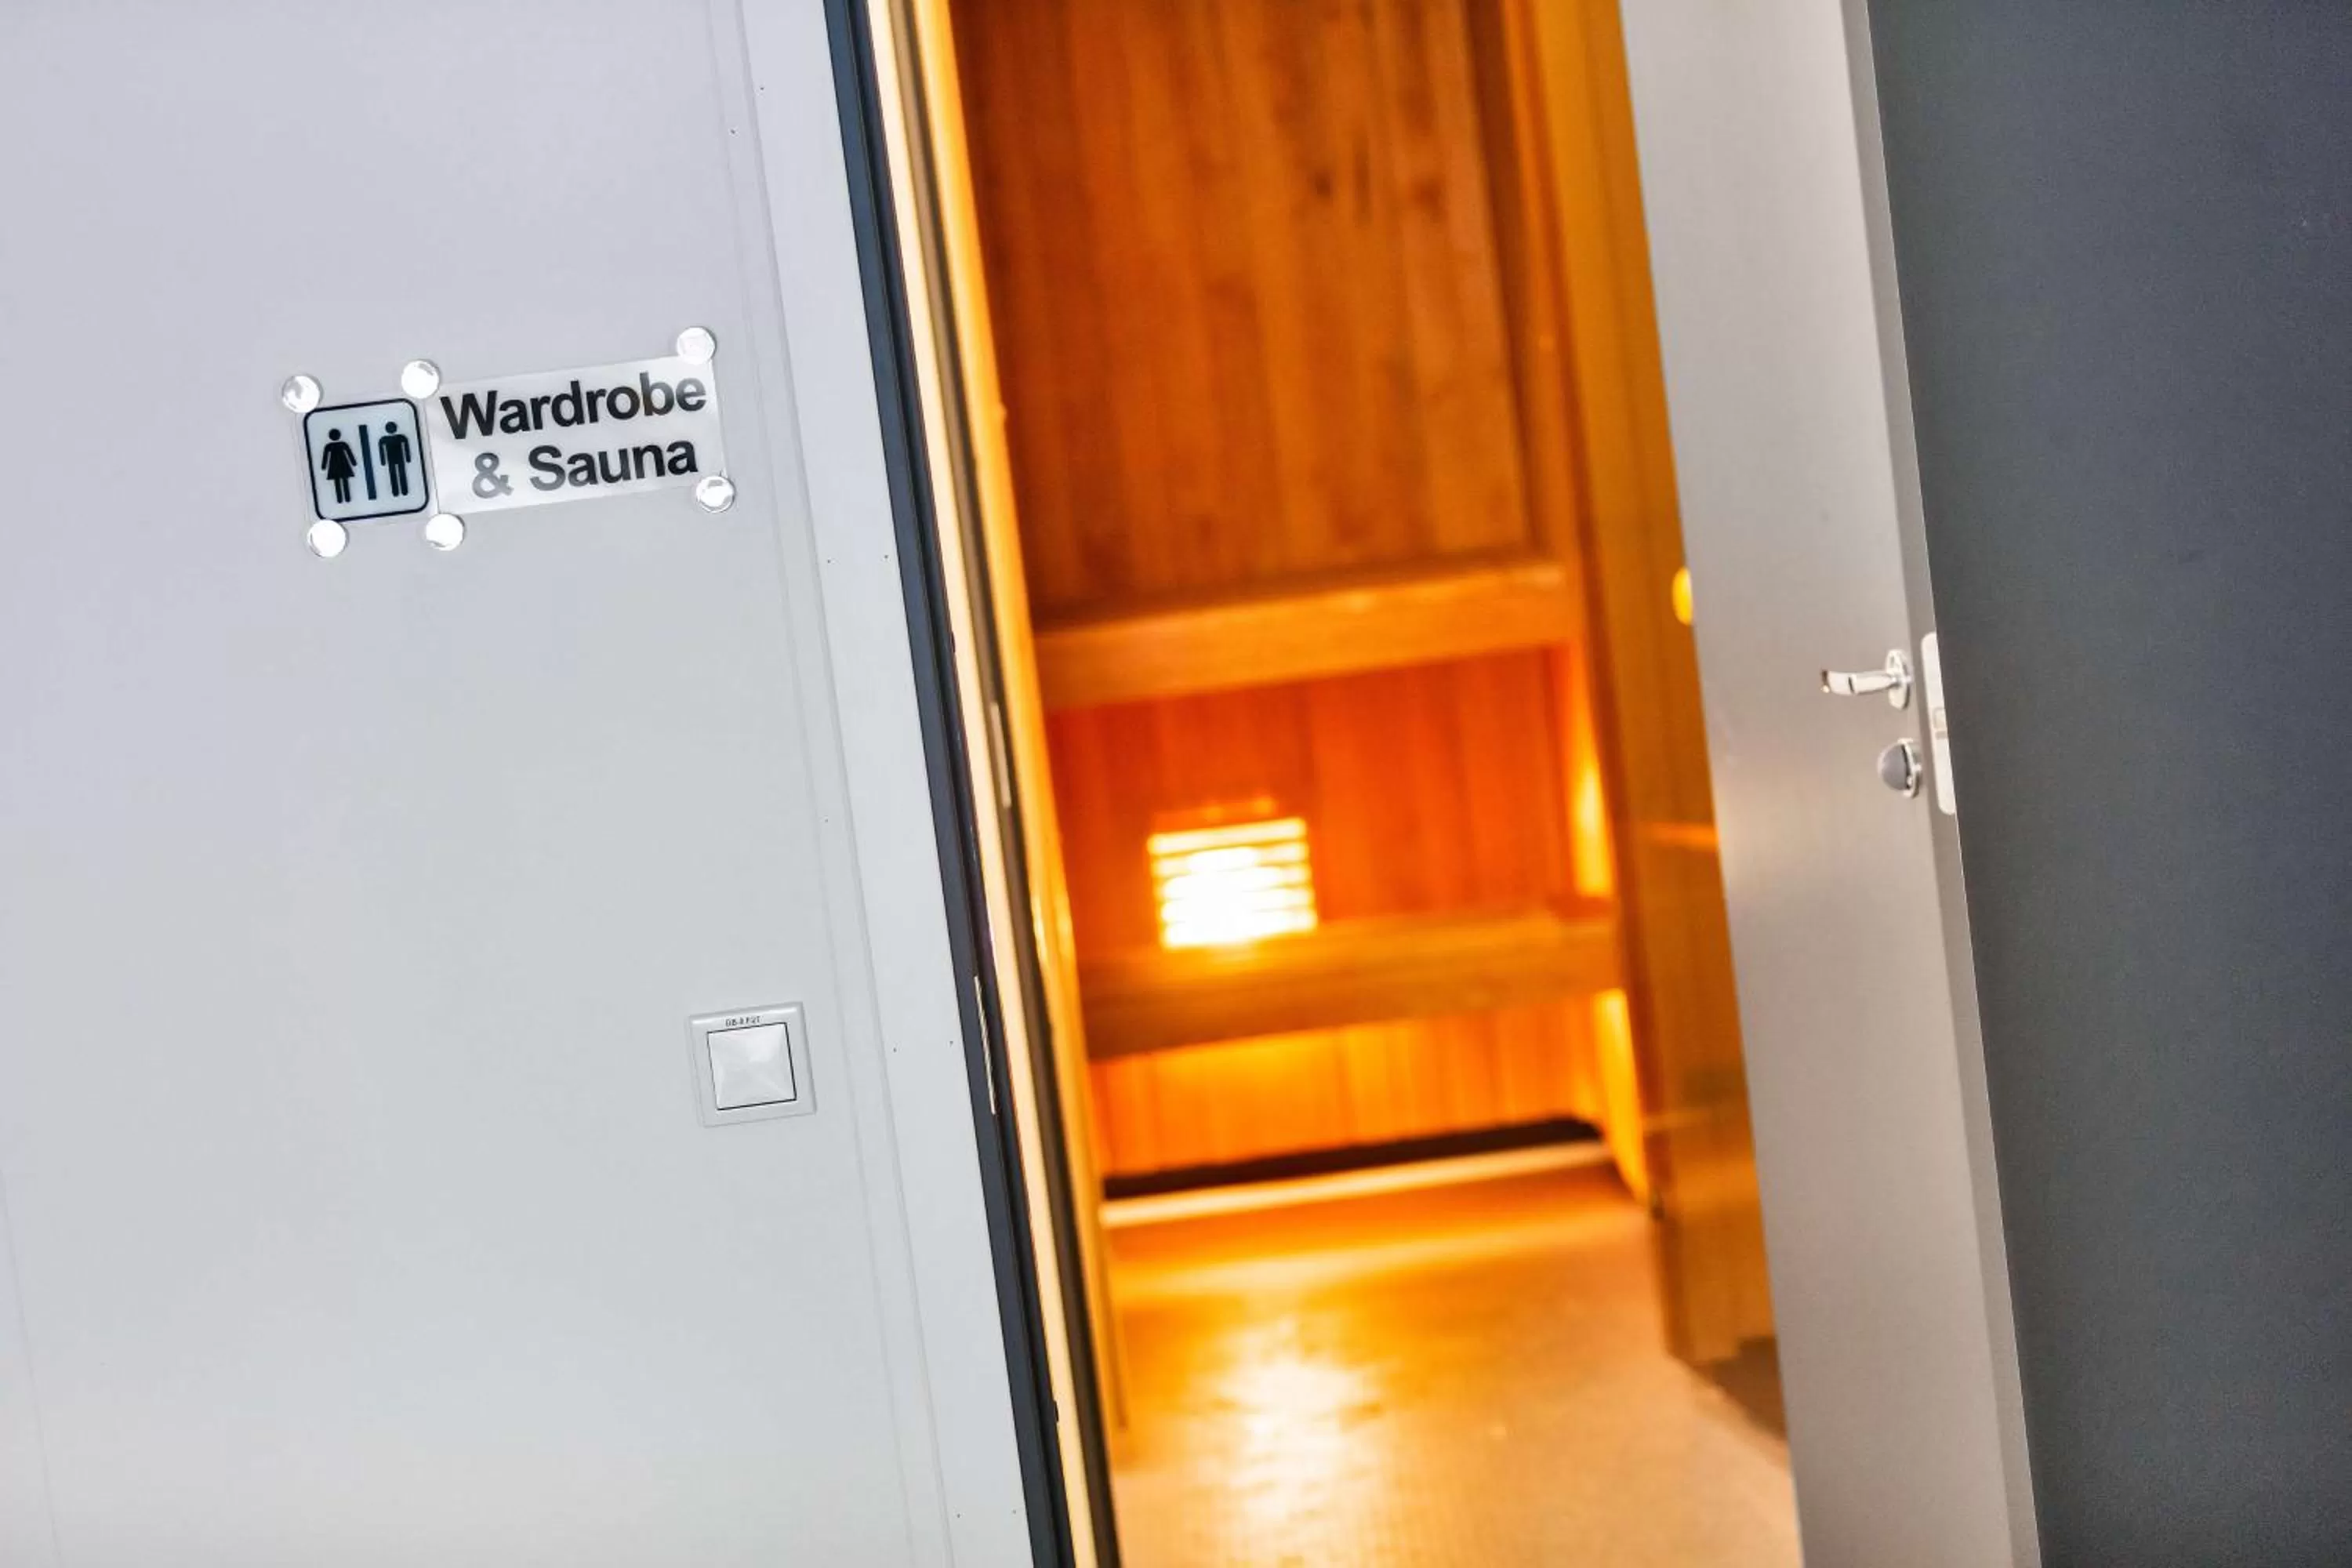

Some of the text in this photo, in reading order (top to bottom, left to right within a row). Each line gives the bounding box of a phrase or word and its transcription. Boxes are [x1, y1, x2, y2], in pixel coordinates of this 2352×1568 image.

[440, 372, 706, 440] Wardrobe
[472, 439, 699, 499] & Sauna
